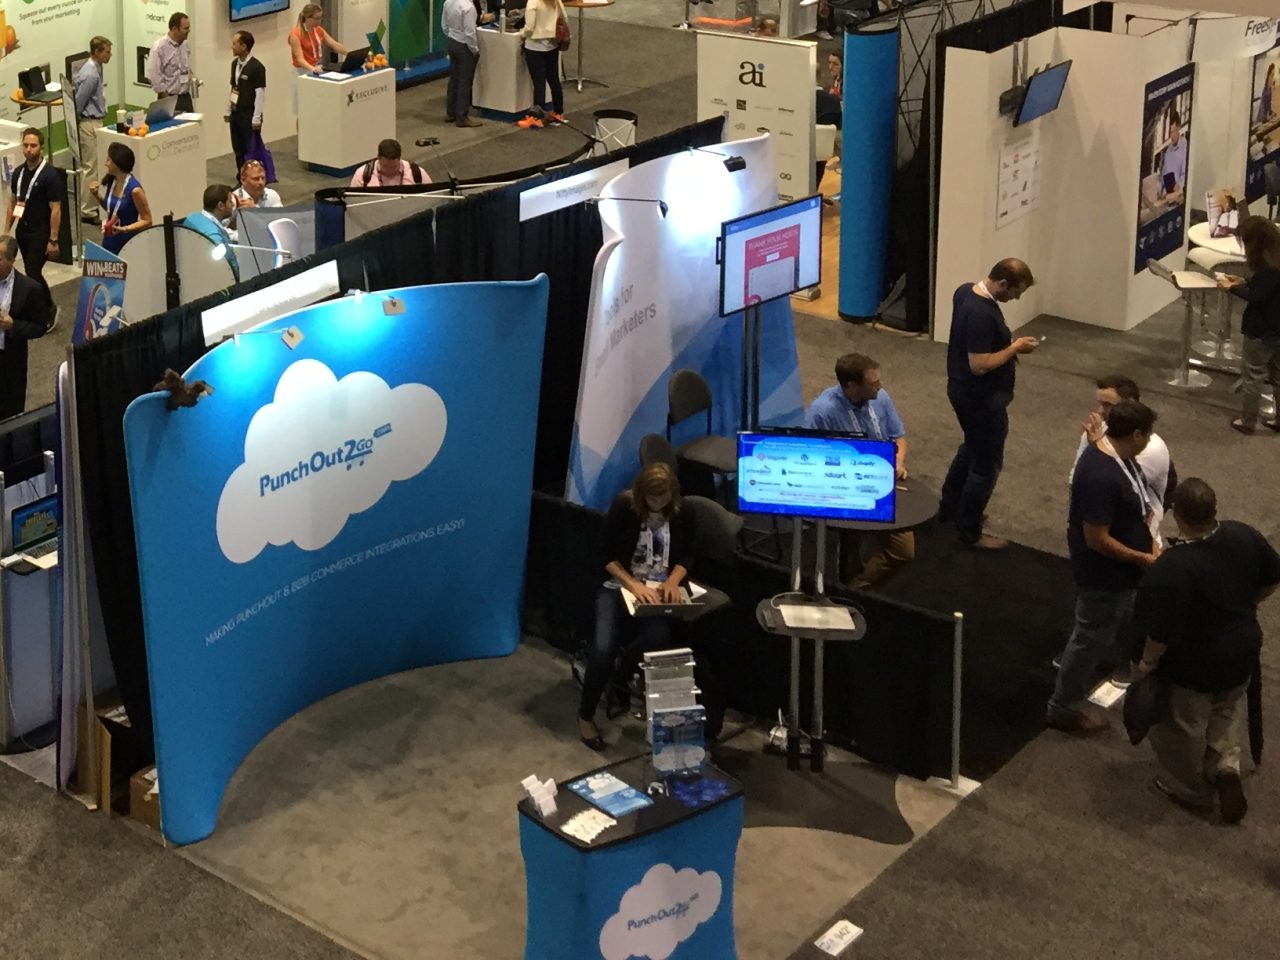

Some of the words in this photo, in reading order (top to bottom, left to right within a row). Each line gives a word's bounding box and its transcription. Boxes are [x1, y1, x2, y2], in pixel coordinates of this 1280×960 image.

[738, 61, 767, 88] ai
[104, 262, 124, 273] BEATS
[259, 438, 374, 498] PunchOut2Go
[205, 620, 236, 647] MAKING
[310, 551, 364, 583] COMMERCE
[365, 526, 436, 560] INTEGRATIONS
